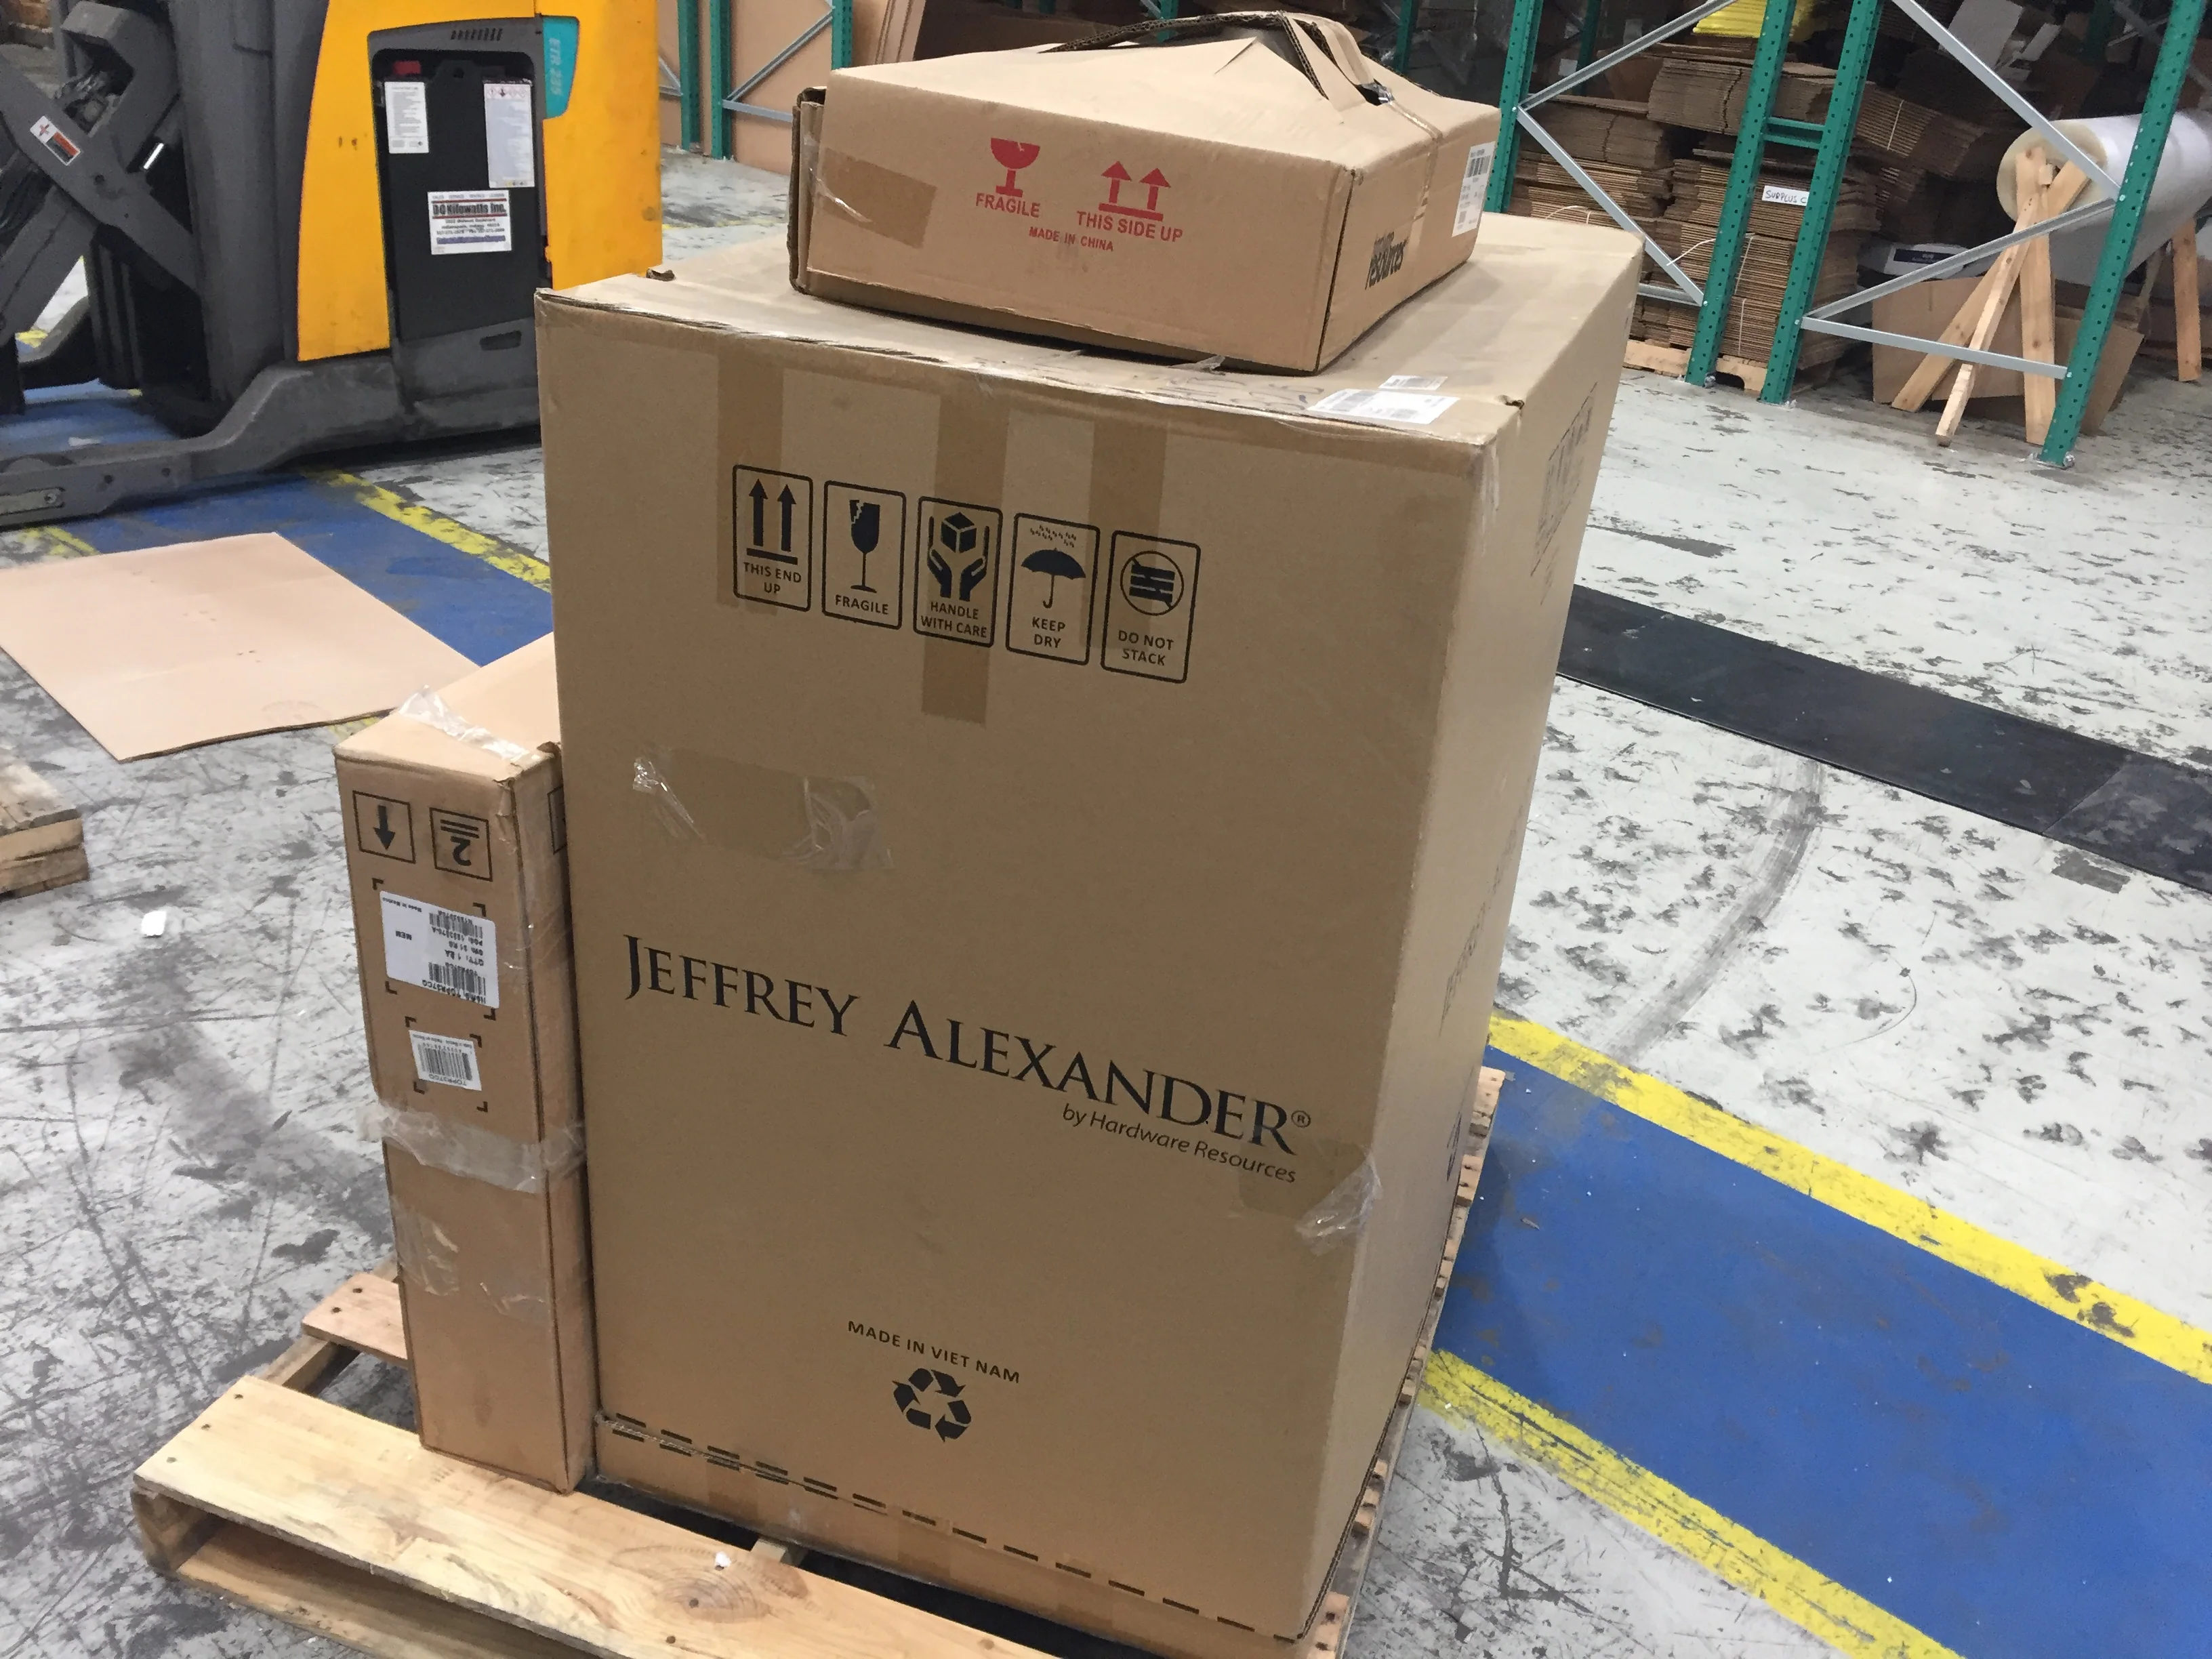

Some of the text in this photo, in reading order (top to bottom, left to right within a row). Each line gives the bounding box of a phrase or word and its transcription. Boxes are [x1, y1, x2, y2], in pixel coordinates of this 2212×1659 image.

[975, 192, 1041, 218] FRAGILE
[1765, 190, 1797, 203] SURPLUS
[1076, 211, 1183, 243] THIS SIDE UP
[1029, 226, 1114, 252] MADE IN CHINA
[743, 562, 802, 583] THIS END
[764, 582, 781, 594] UP
[835, 594, 888, 615] FRAGILE
[930, 601, 979, 620] HANDLE
[920, 615, 987, 638] WITH CARE
[1031, 616, 1066, 632] KEEP
[1033, 634, 1061, 649] DRY
[1118, 630, 1174, 651] DO NOT
[1122, 648, 1166, 666] STACK
[623, 934, 861, 1037] JEFFREY
[1062, 1103, 1296, 1184] by Hardware Resources
[848, 1320, 1020, 1384] MADE IN VIET NAM
